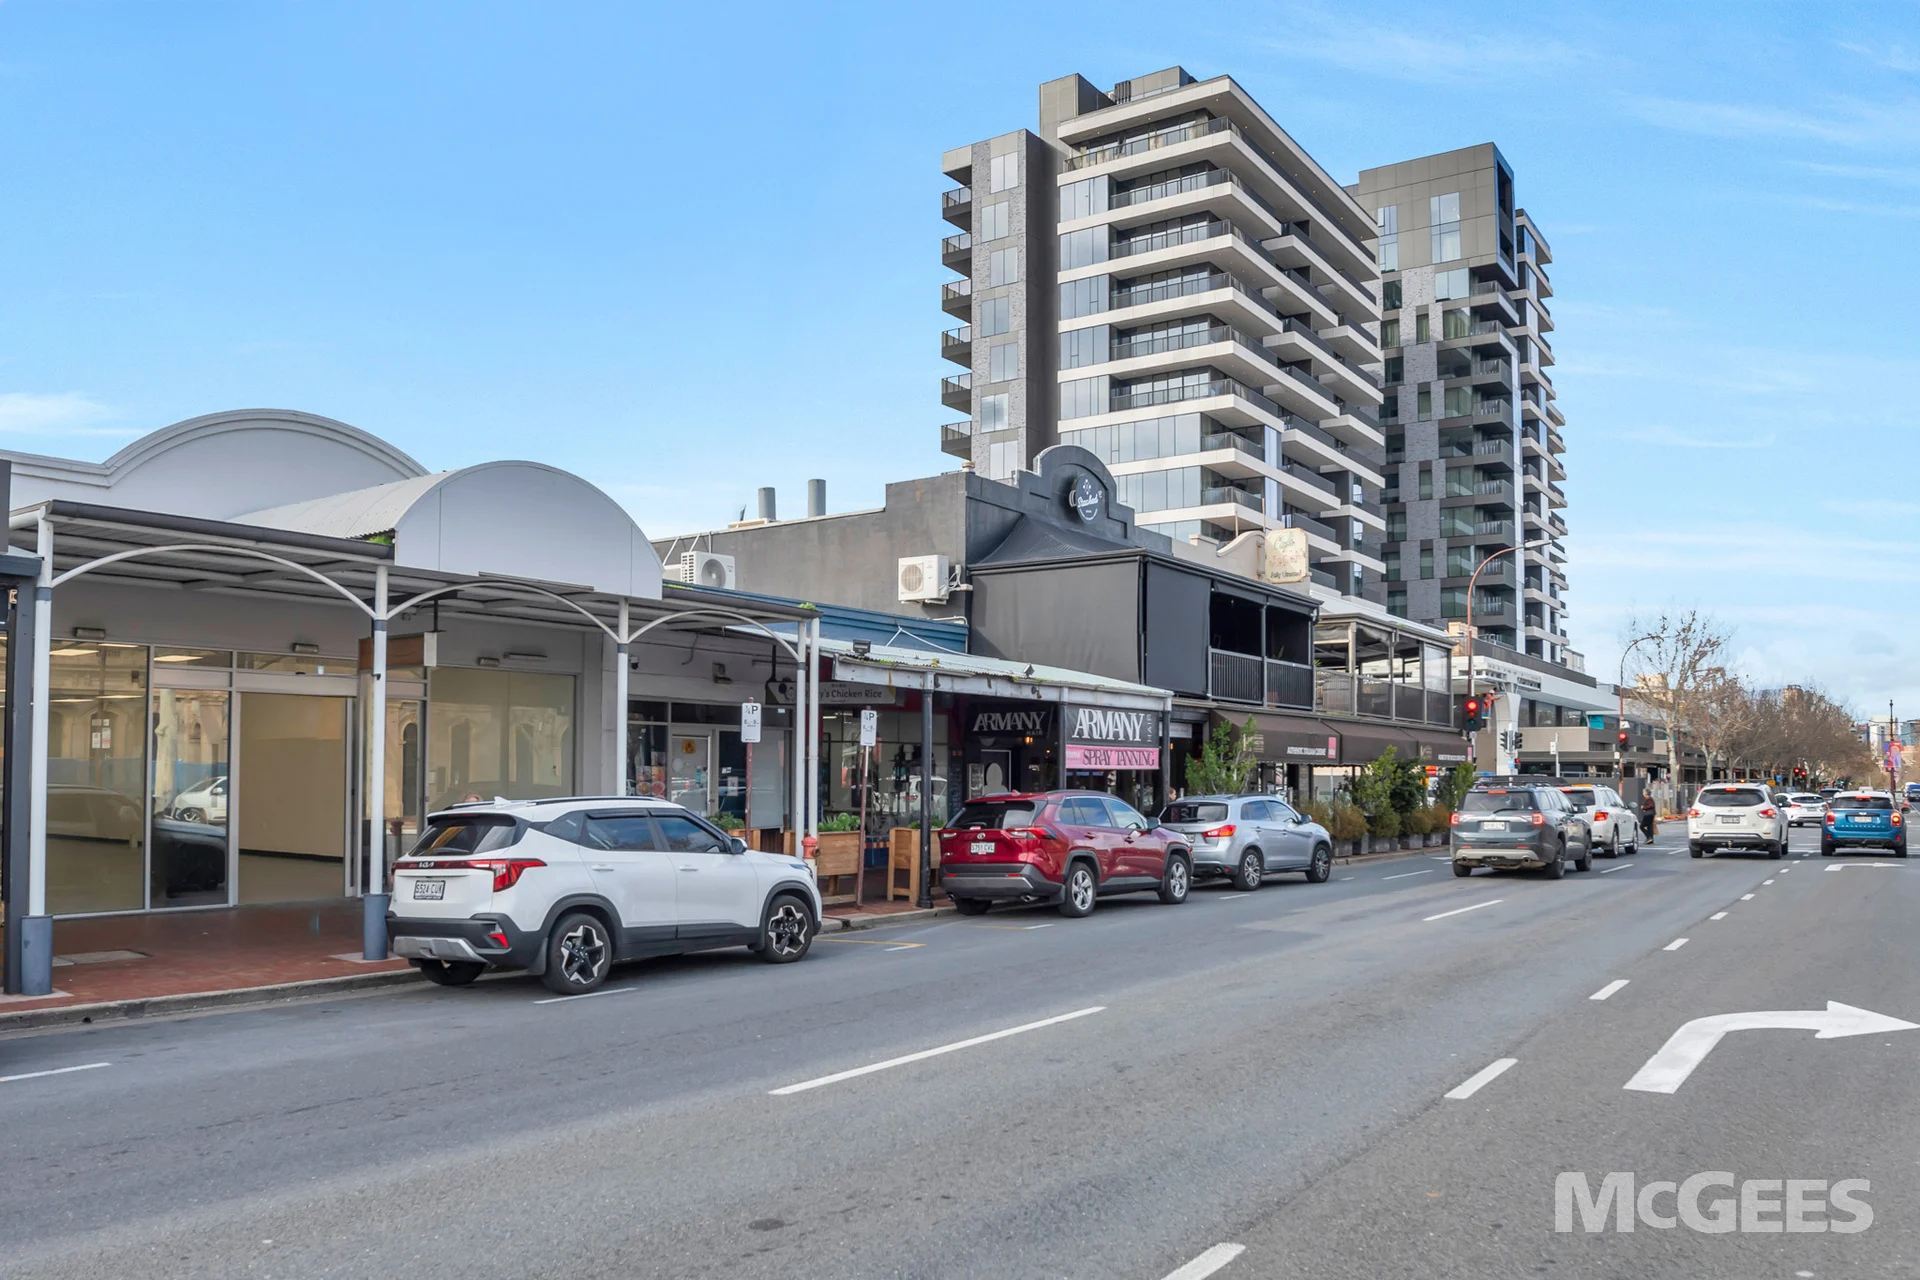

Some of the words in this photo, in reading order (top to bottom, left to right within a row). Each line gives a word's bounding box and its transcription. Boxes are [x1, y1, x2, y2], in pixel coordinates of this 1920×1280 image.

[831, 688, 862, 699] Chicken
[864, 688, 882, 699] Rice
[972, 711, 1047, 732] ARMANY
[1071, 708, 1145, 742] ARMANY
[1082, 748, 1114, 766] SPRAY
[1114, 749, 1156, 768] TANNING
